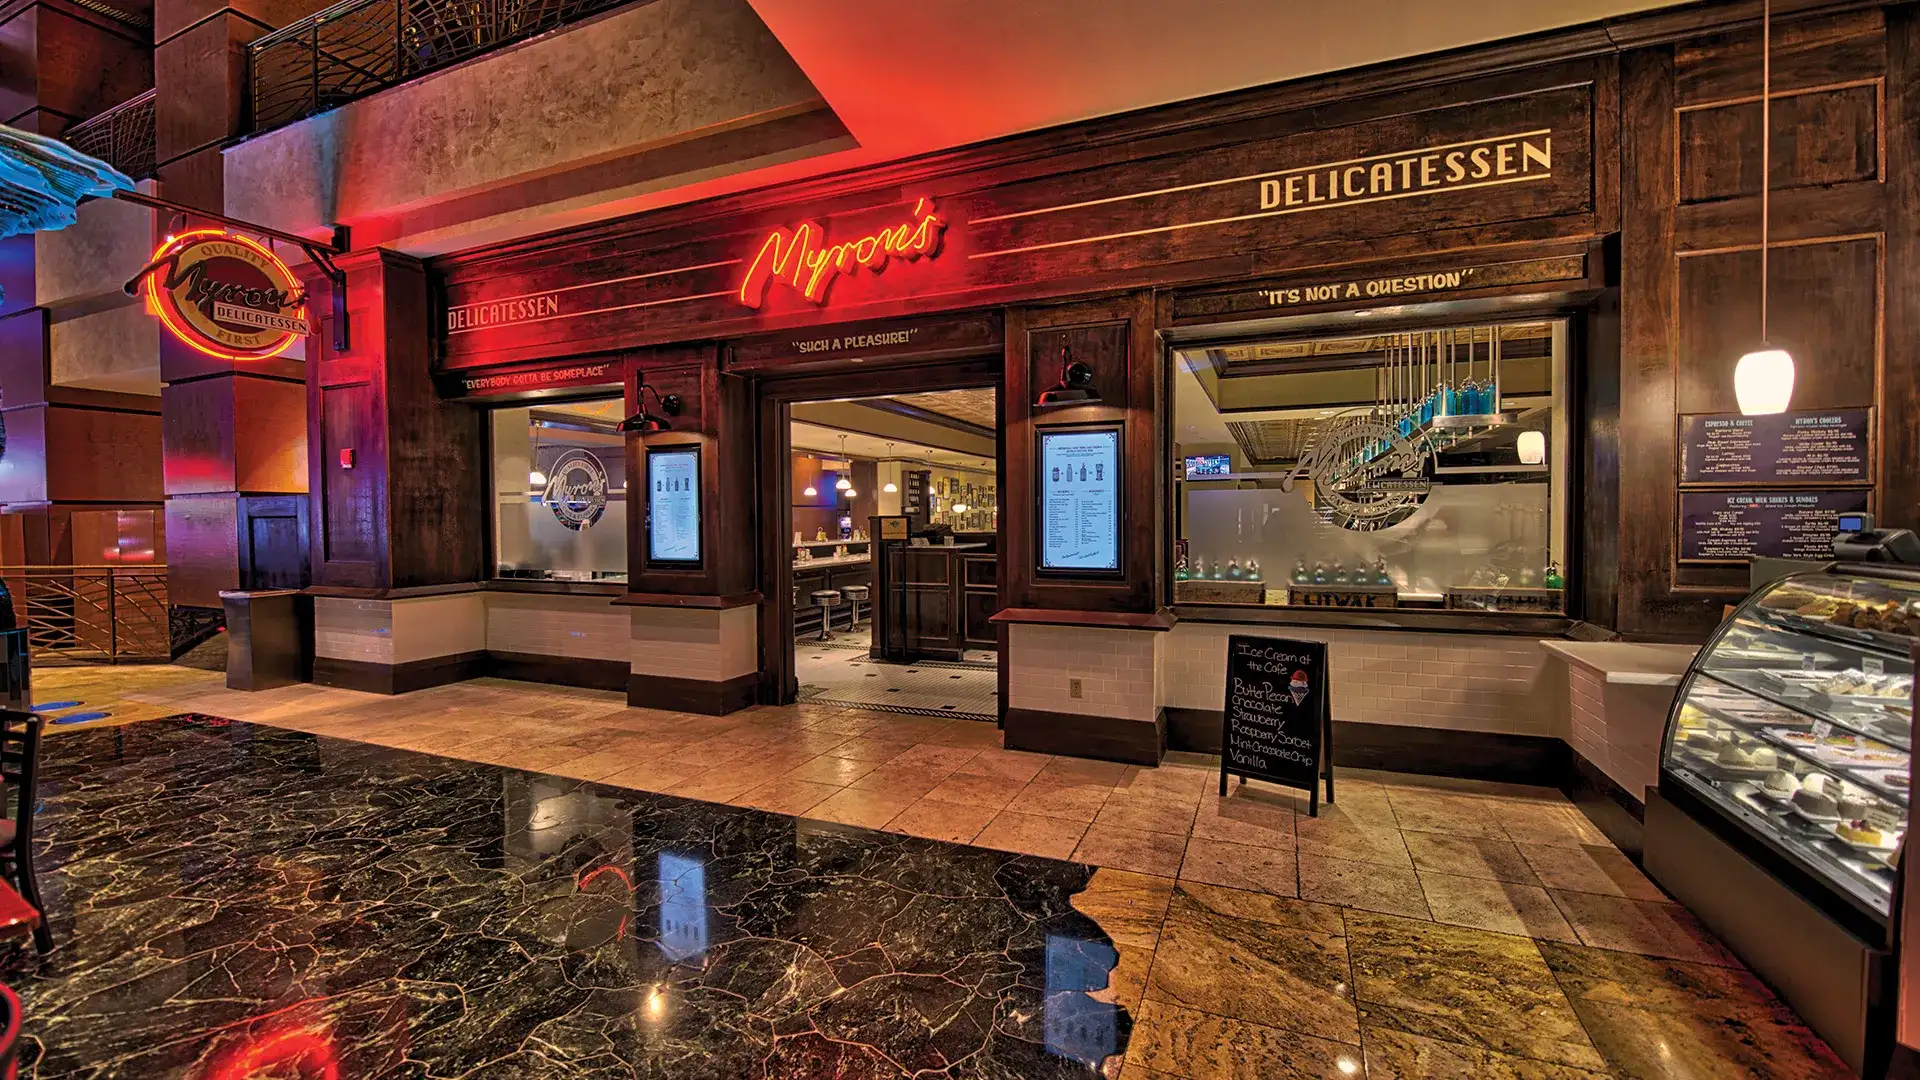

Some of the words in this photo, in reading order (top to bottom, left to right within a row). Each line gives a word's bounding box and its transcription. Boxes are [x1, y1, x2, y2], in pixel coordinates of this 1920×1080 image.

[1261, 138, 1551, 210] DELICATESSEN
[200, 244, 270, 267] QUALITY
[741, 198, 938, 303] Myron's
[1305, 284, 1341, 302] NOT
[1345, 283, 1361, 299] A
[217, 307, 307, 332] DELICATESSEN
[448, 295, 559, 330] DELICATESSEN
[216, 330, 261, 345] FIRST
[832, 338, 841, 351] A
[513, 373, 538, 385] GOTTA
[541, 371, 552, 381] BE
[1238, 644, 1263, 656] Ice
[1264, 647, 1297, 662] Cream
[1300, 654, 1312, 665] at
[1247, 660, 1262, 672] the
[1263, 662, 1287, 675] Cafe
[1234, 677, 1264, 699] Butter
[1262, 681, 1295, 703] Pecan
[1233, 705, 1286, 730] Strawberry
[1231, 719, 1277, 743] Raspberry
[1278, 730, 1312, 749] Sorbet
[1230, 734, 1252, 748] Mint
[1290, 751, 1313, 767] Chip
[1230, 748, 1267, 769] Vanilla
